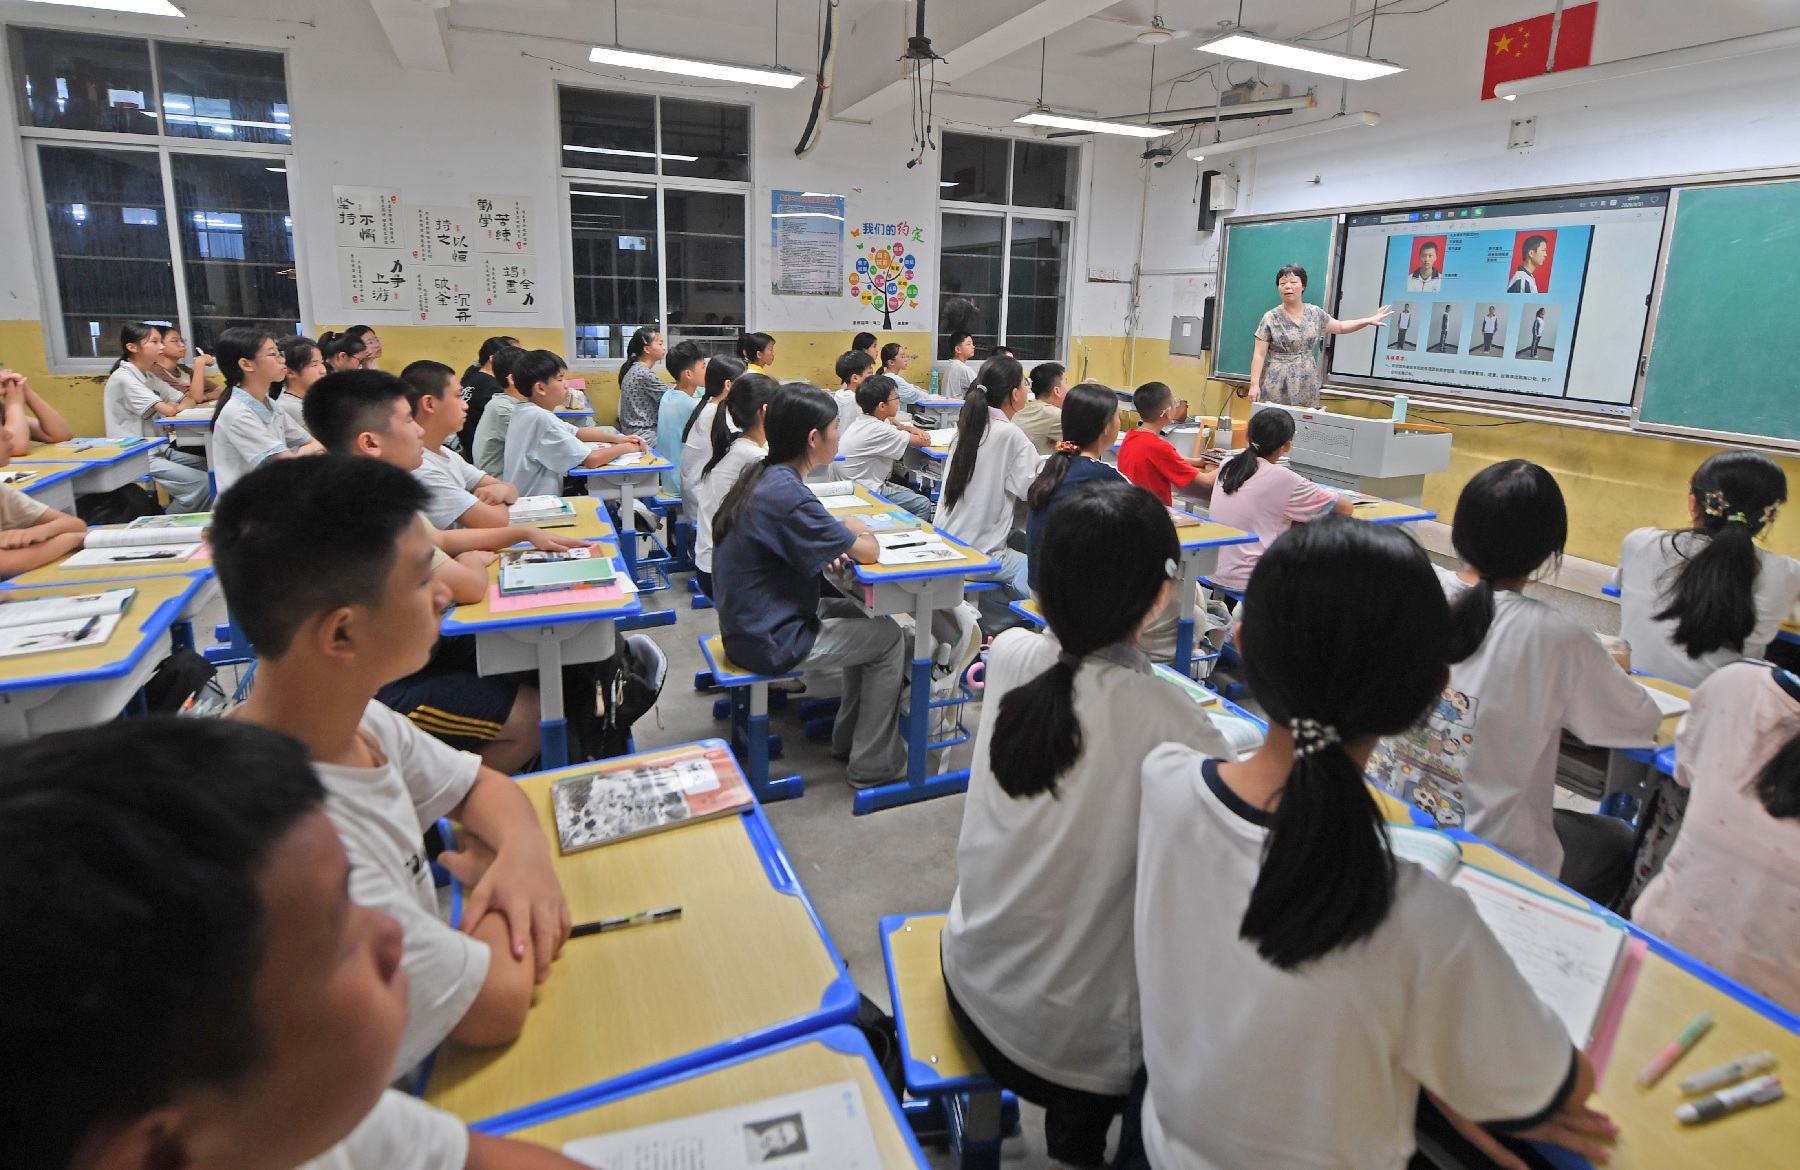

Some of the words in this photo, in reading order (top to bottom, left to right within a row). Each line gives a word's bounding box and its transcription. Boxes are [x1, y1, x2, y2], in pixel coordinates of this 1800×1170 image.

[336, 197, 356, 225] 坚持
[435, 218, 452, 245] 持之
[863, 221, 925, 243] 我们的约定
[452, 235, 469, 262] 以恒
[371, 273, 390, 302] 上游
[390, 259, 406, 288] 力争
[434, 277, 452, 306] 破釜
[519, 278, 535, 306] 全力
[454, 293, 472, 322] 沉舟
